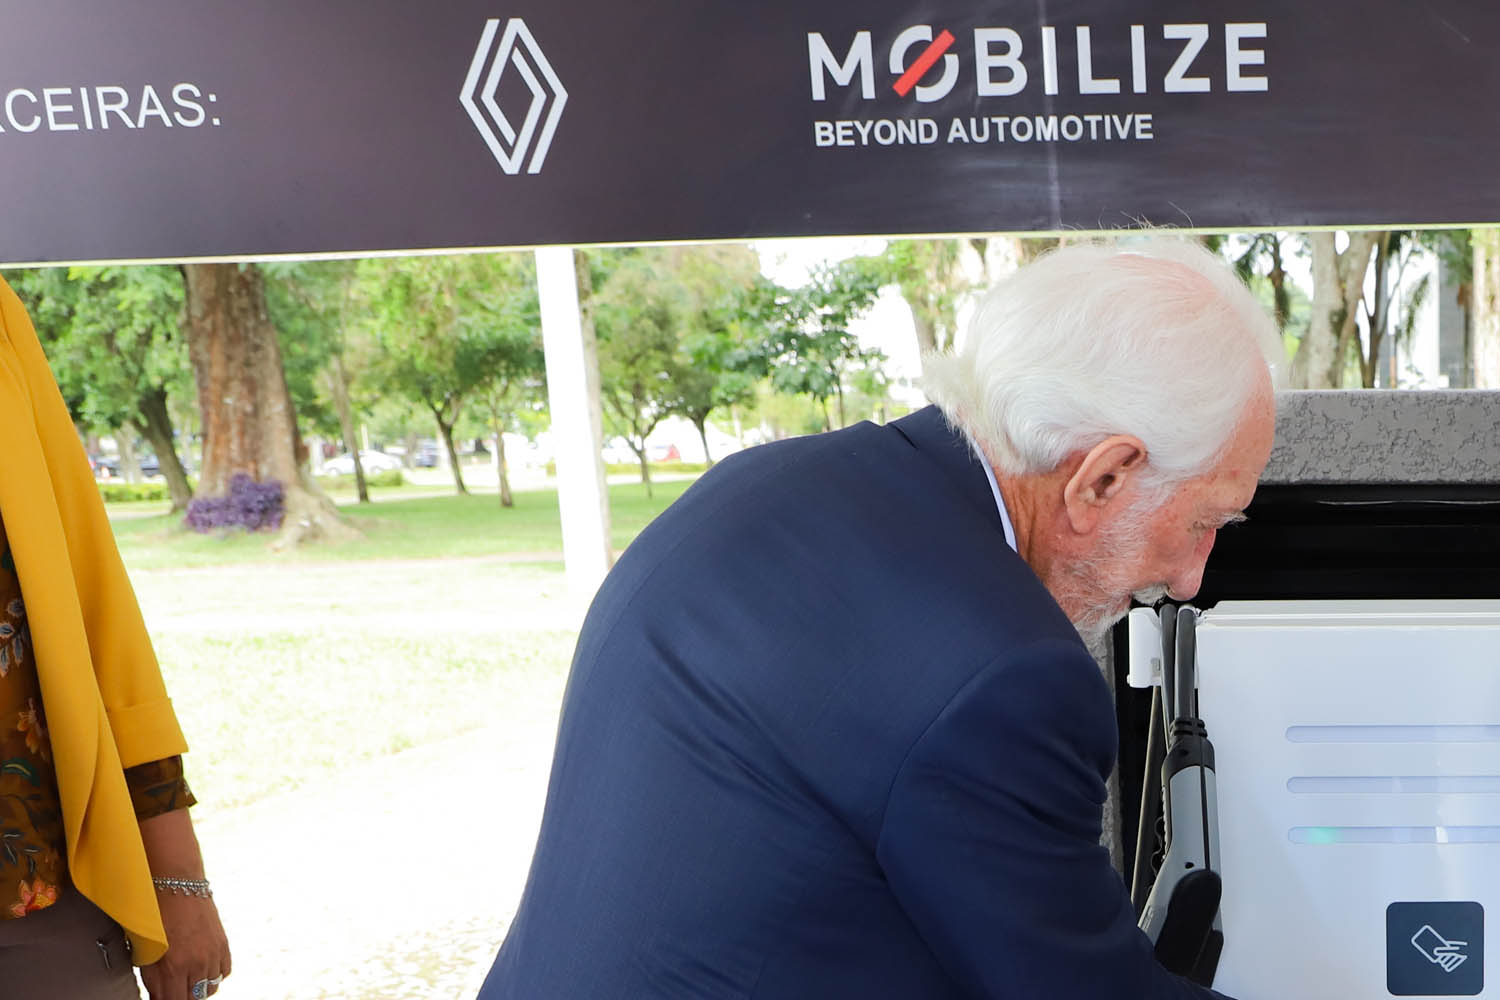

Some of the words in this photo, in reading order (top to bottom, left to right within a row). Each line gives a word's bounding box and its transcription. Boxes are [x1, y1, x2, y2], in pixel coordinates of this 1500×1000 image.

[807, 23, 1269, 103] MOBILIZE
[0, 83, 221, 133] CEIRAS:
[814, 118, 939, 147] BEYOND
[947, 113, 1154, 143] AUTOMOTIVE
